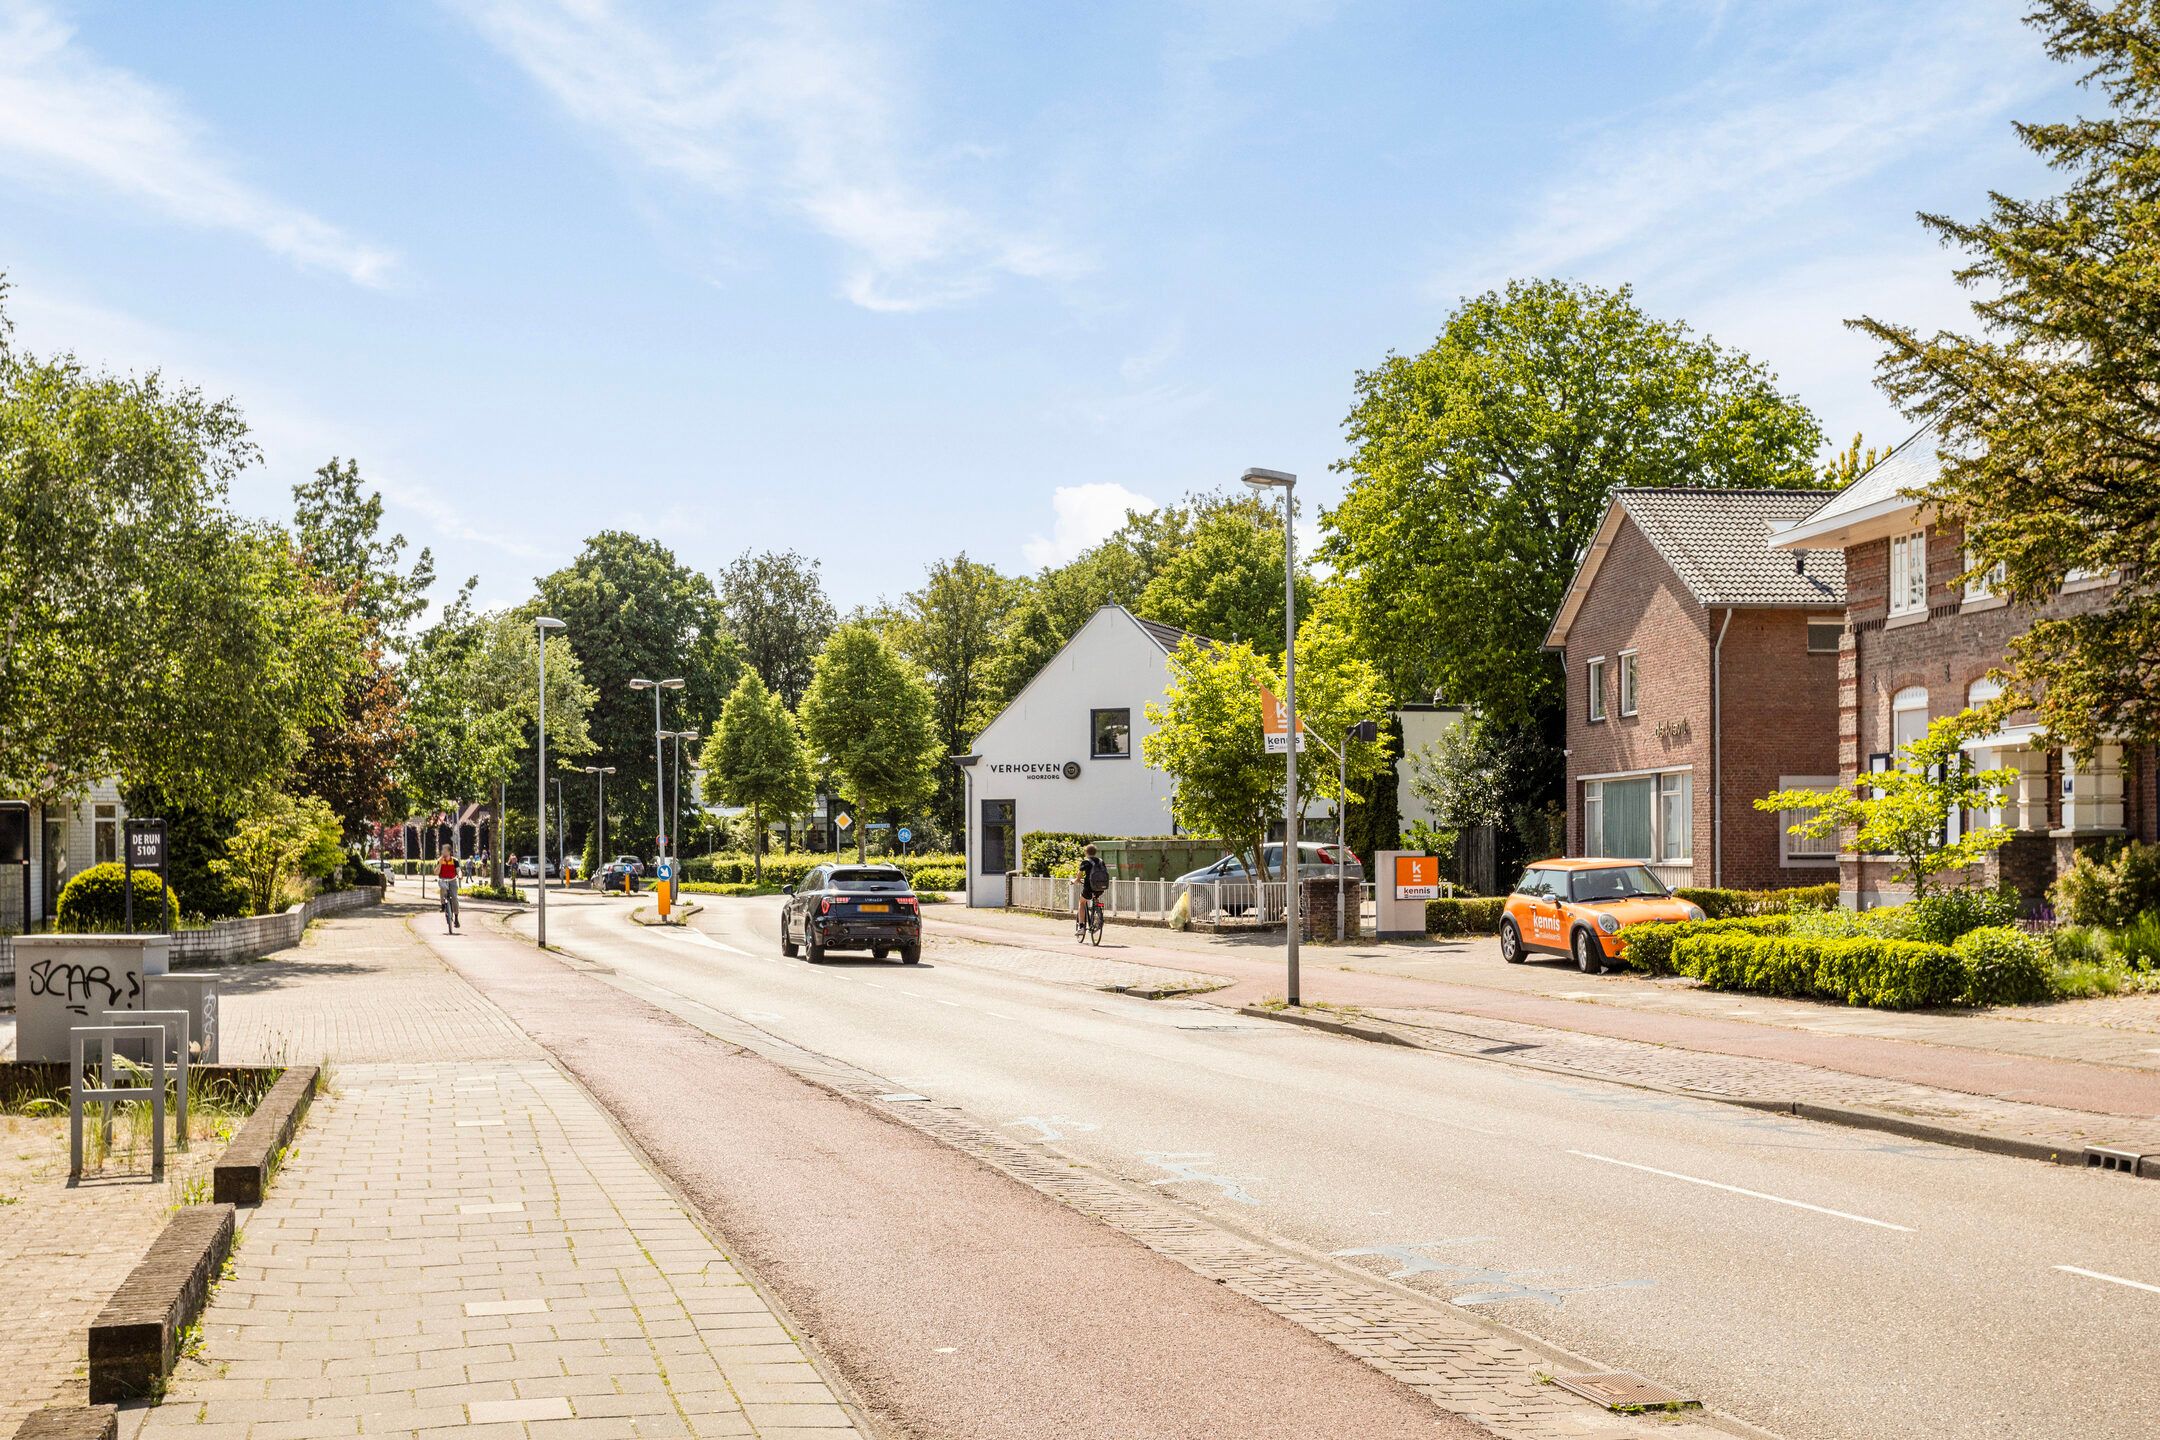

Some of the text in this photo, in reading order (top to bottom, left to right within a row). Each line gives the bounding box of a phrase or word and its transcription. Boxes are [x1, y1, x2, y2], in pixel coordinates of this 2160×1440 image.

[1267, 736, 1301, 745] kens
[990, 763, 1061, 773] VERHOEVEN
[132, 834, 160, 845] DE RUN
[137, 845, 157, 856] 5100
[1403, 887, 1431, 895] kennis
[1533, 911, 1561, 932] kennis
